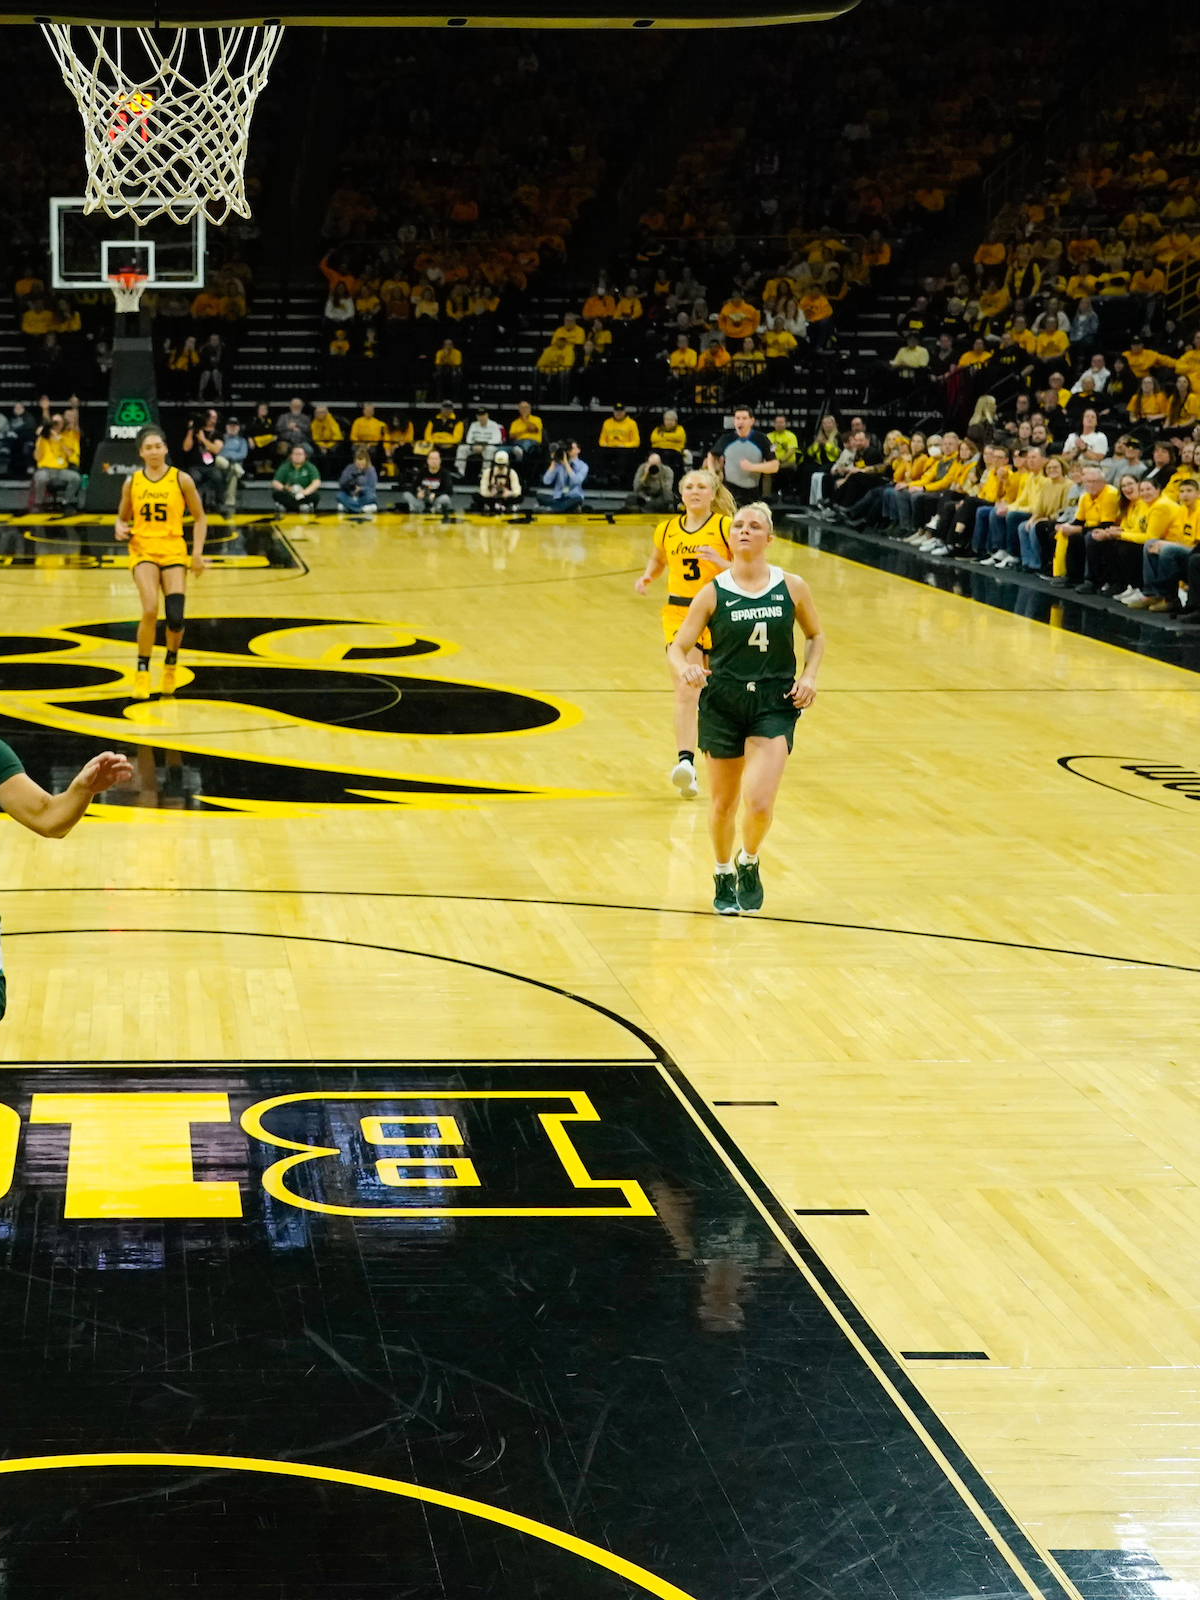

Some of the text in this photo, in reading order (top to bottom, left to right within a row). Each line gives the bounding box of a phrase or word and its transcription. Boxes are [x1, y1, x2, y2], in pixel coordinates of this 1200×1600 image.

[140, 503, 167, 522] 45
[671, 541, 708, 556] Iow
[682, 558, 701, 581] 3
[730, 605, 783, 622] SPARTANS
[747, 621, 769, 653] 4
